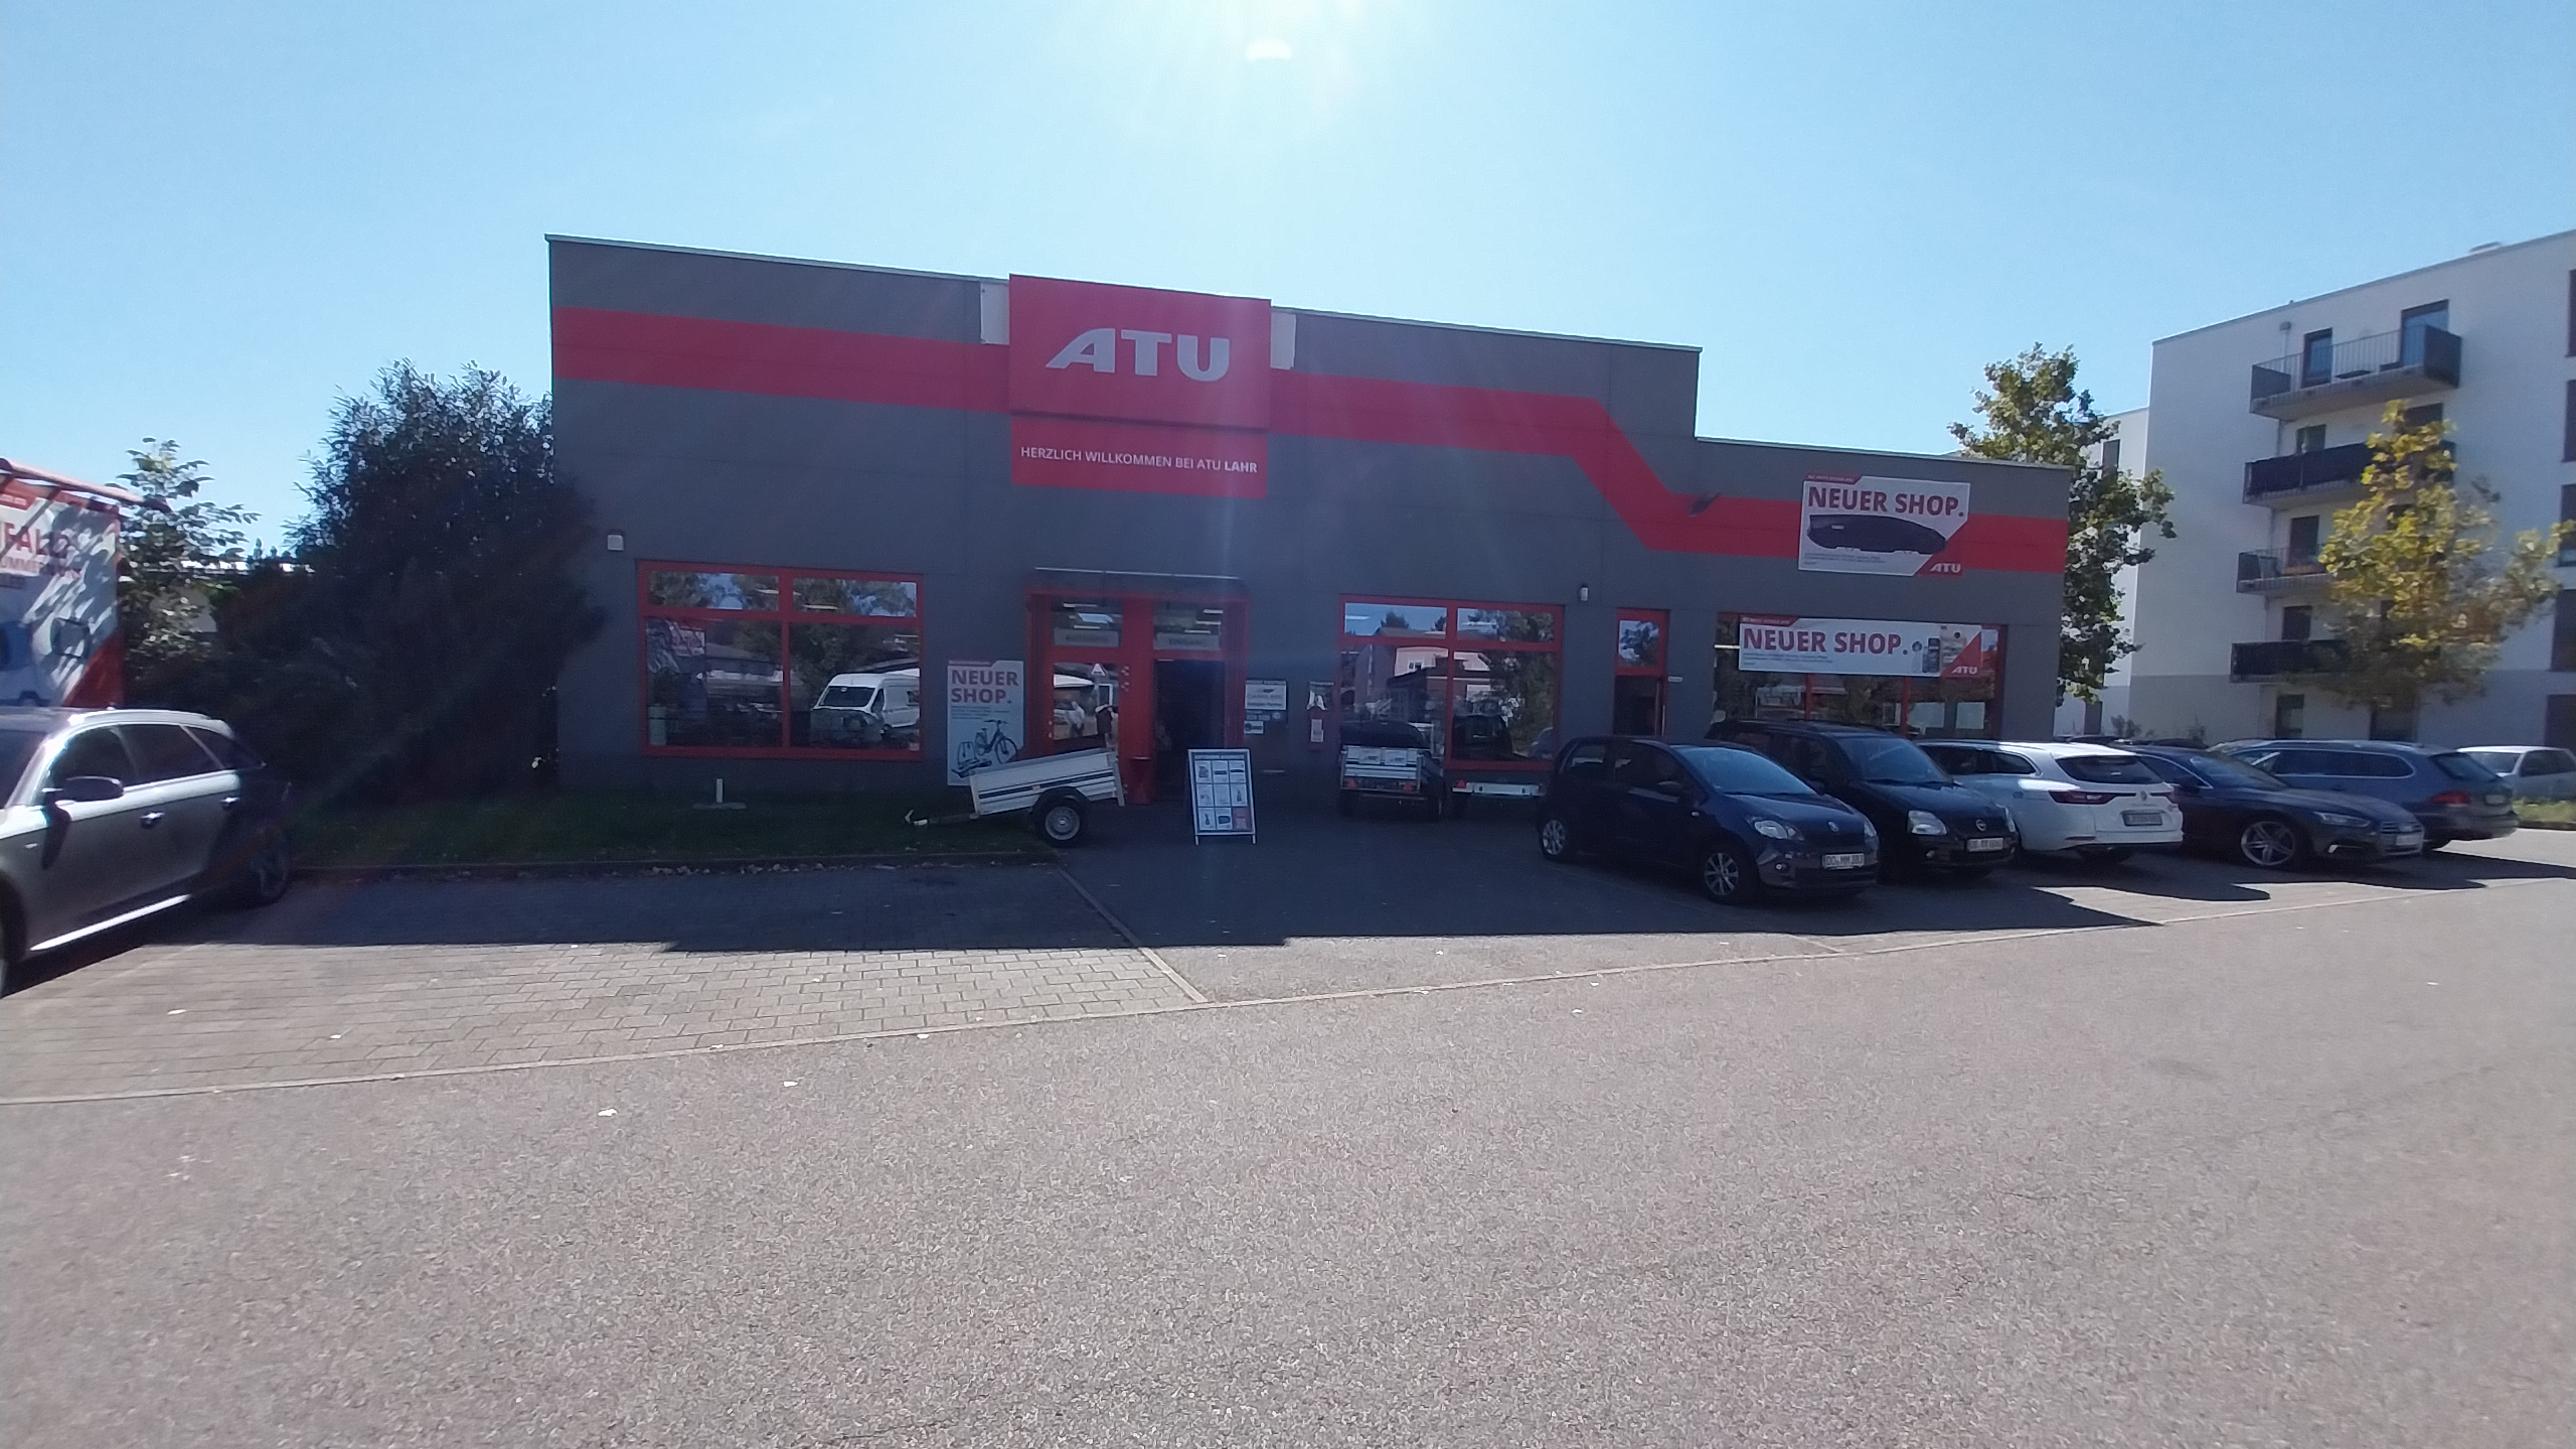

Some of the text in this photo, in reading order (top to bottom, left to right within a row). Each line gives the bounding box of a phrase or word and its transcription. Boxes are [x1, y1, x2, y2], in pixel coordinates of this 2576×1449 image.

[1045, 327, 1231, 382] ATU
[1020, 447, 1258, 473] HERZLICH WILLKOMMEN BEI ATU LAHR
[1808, 486, 1964, 517] NEUER SHOP.
[1930, 562, 1961, 573] ATU
[1743, 627, 1908, 656] NEUER SHOP.
[951, 669, 1019, 687] NEUER
[1951, 665, 1978, 676] ATU
